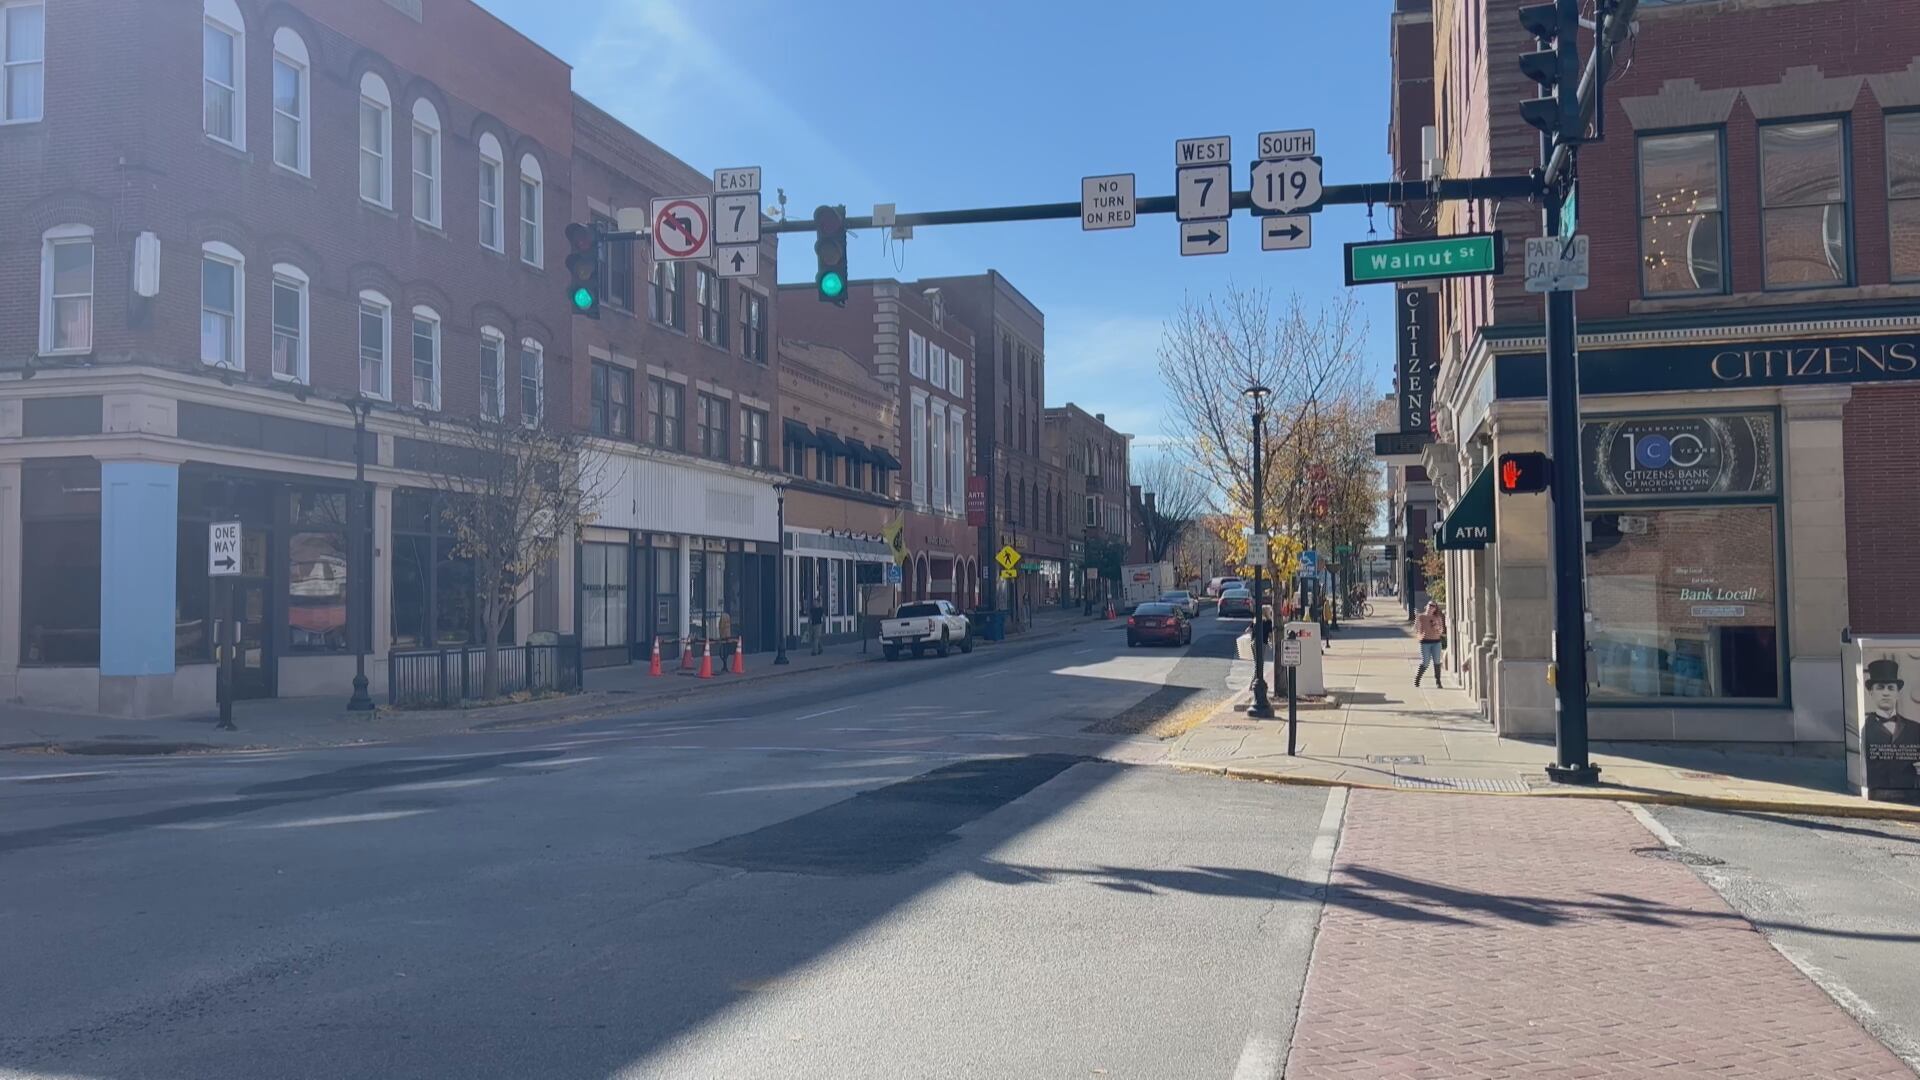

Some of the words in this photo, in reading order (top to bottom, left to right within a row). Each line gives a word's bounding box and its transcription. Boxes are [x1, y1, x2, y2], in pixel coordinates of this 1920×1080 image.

[1182, 143, 1225, 161] WEST
[1263, 135, 1311, 154] SOUTH
[720, 172, 754, 189] EAST
[1098, 181, 1118, 193] NO
[1265, 171, 1307, 202] 119
[1193, 177, 1214, 207] 7
[1093, 196, 1124, 208] TURN
[729, 205, 746, 232] 7
[1087, 213, 1103, 224] ON
[1108, 210, 1131, 223] RED
[1371, 249, 1453, 270] Walnut
[1459, 247, 1475, 258] St
[1406, 291, 1423, 427] CITIZENS
[1711, 343, 1917, 380] CITIZENS
[1624, 470, 1675, 480] CITIZENS
[1678, 469, 1709, 478] BANK
[1640, 479, 1709, 487] MORGANTOWN
[968, 491, 985, 499] ARTS
[215, 526, 236, 539] ONE
[1455, 526, 1487, 538] ATM
[214, 540, 236, 553] WAY
[1680, 587, 1712, 601] Bank
[1717, 586, 1757, 601] Local!
